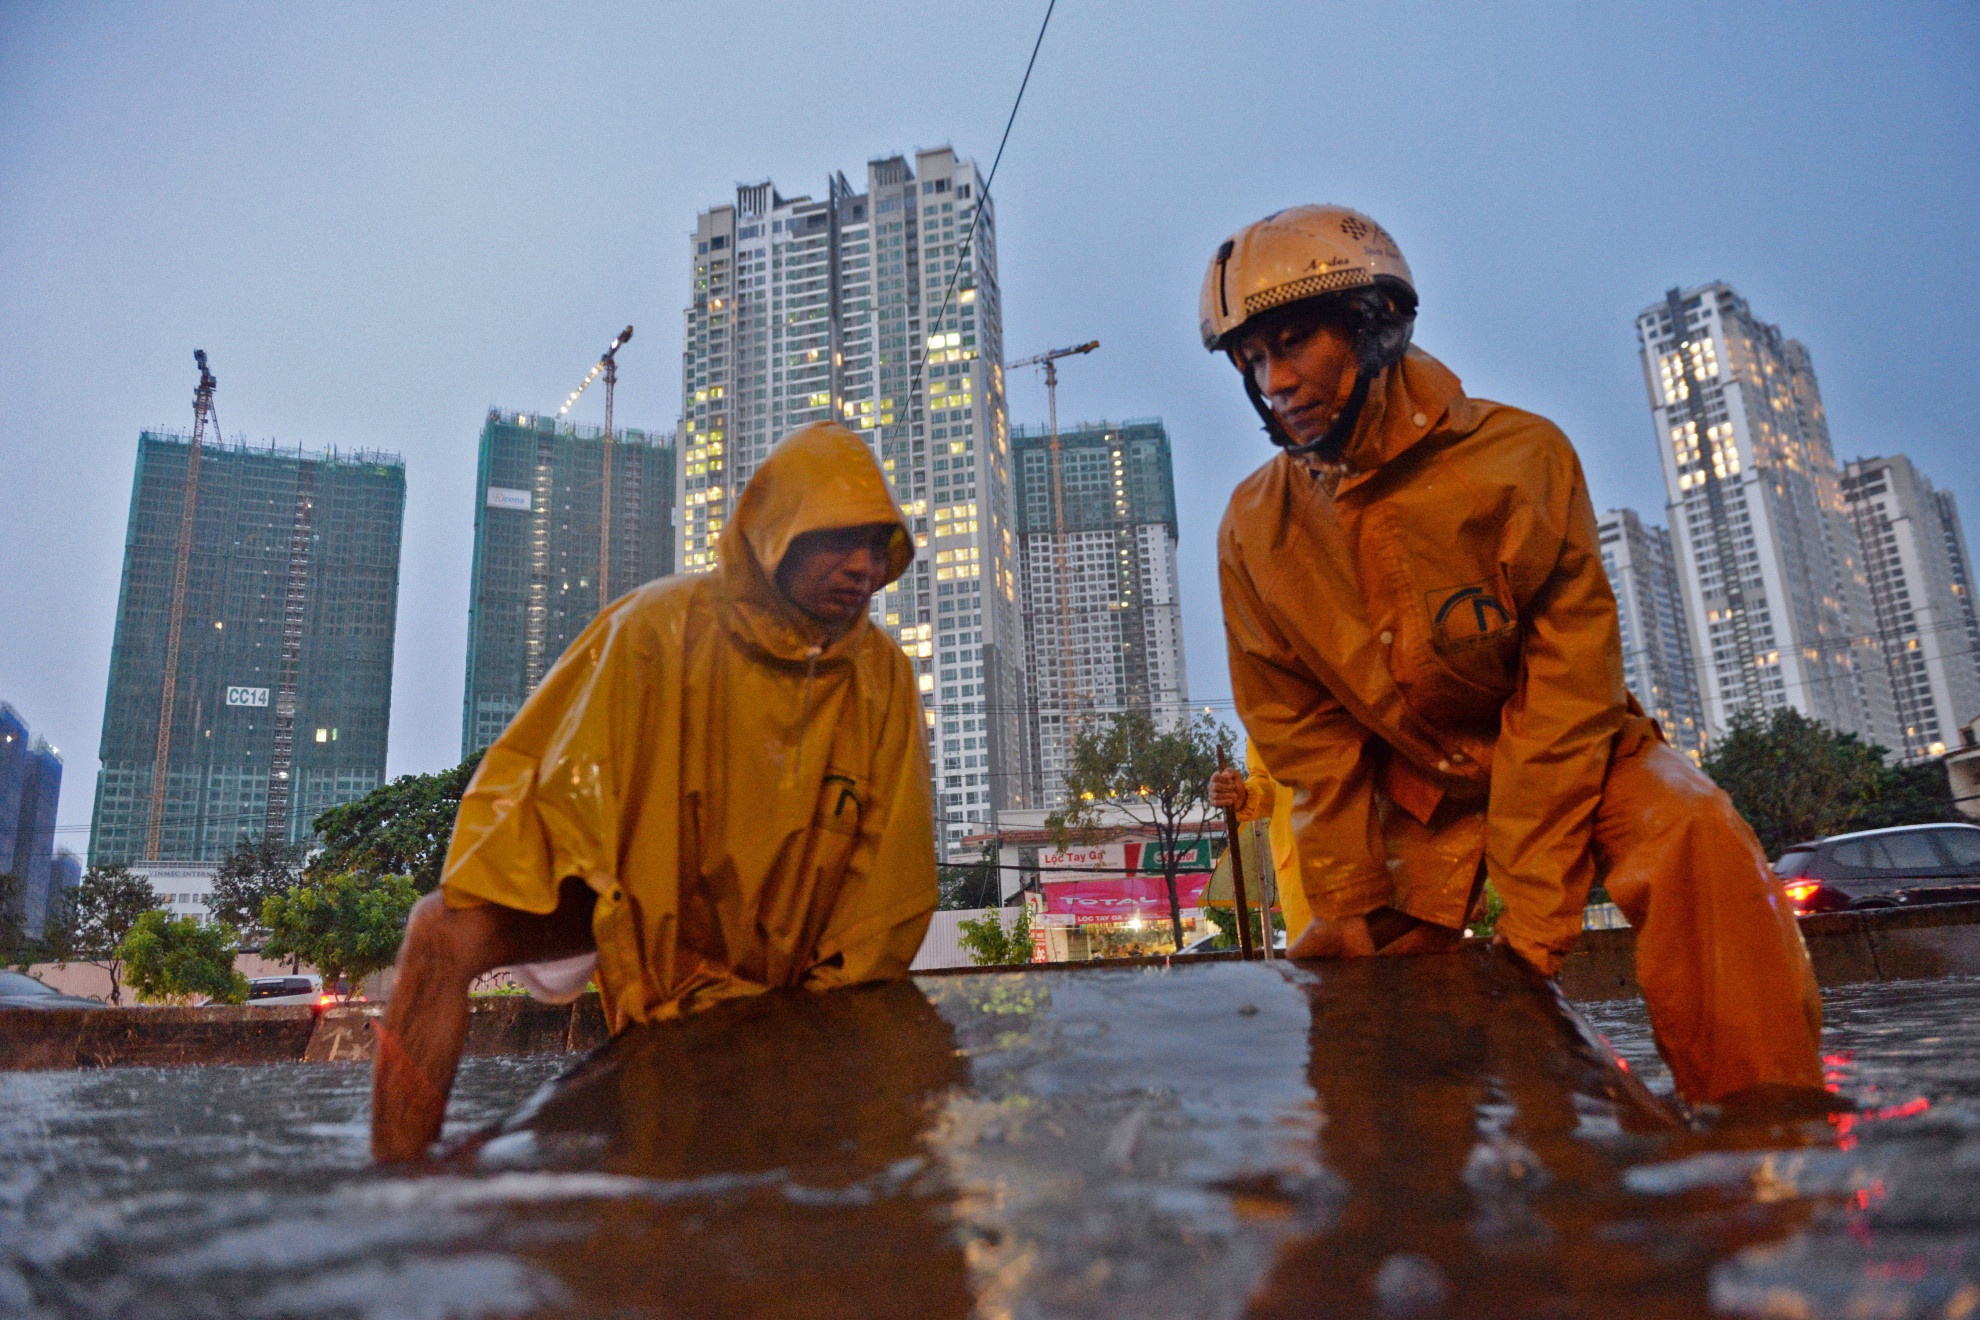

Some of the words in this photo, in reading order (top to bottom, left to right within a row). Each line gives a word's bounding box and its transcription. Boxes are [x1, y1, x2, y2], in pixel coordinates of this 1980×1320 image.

[1303, 257, 1349, 272] Ades
[229, 688, 266, 704] CC14
[1066, 852, 1085, 862] Tay
[1089, 850, 1103, 860] Ga
[1059, 896, 1157, 906] TOTAL
